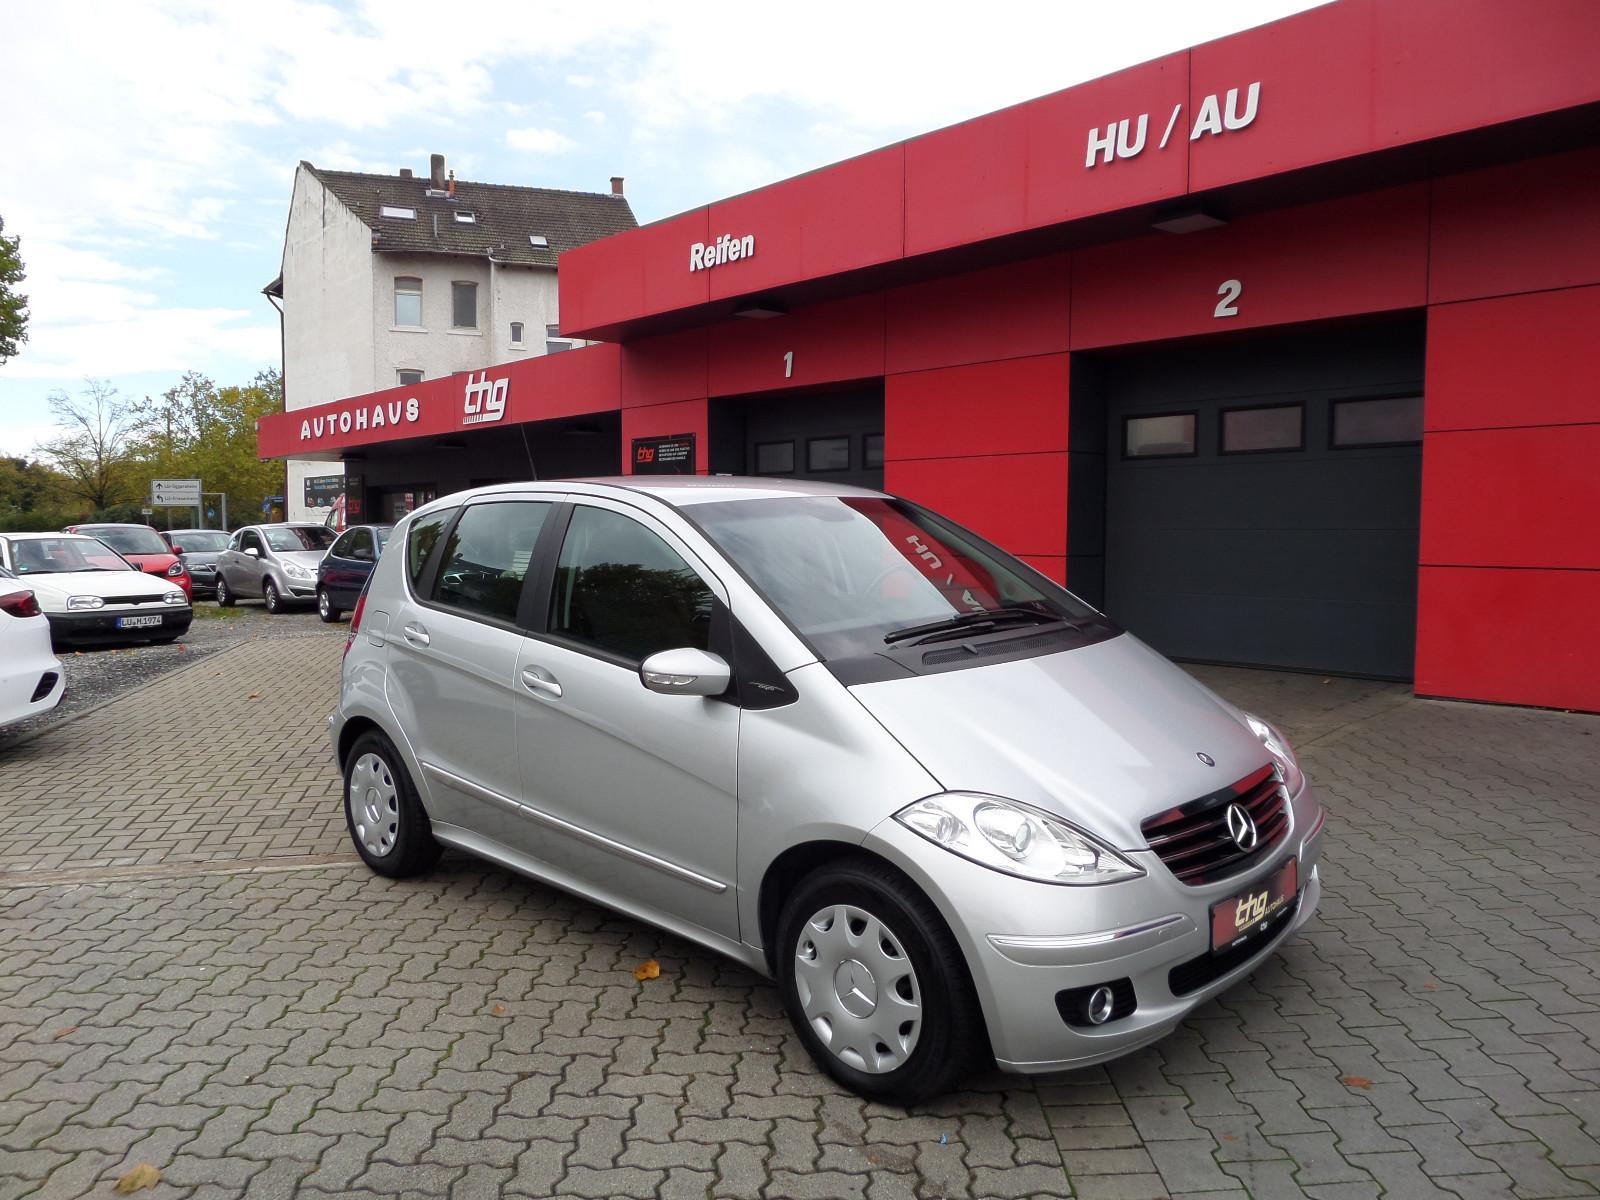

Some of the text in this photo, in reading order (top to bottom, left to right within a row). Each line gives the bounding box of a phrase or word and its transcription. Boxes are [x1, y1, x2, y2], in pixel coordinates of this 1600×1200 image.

[1086, 114, 1148, 167] HU
[1190, 82, 1261, 140] AU
[690, 234, 755, 272] Reifen
[1214, 279, 1242, 318] 2
[783, 351, 793, 378] 1
[301, 371, 509, 440] AUTOHAUS thg
[1235, 890, 1269, 931] thg
